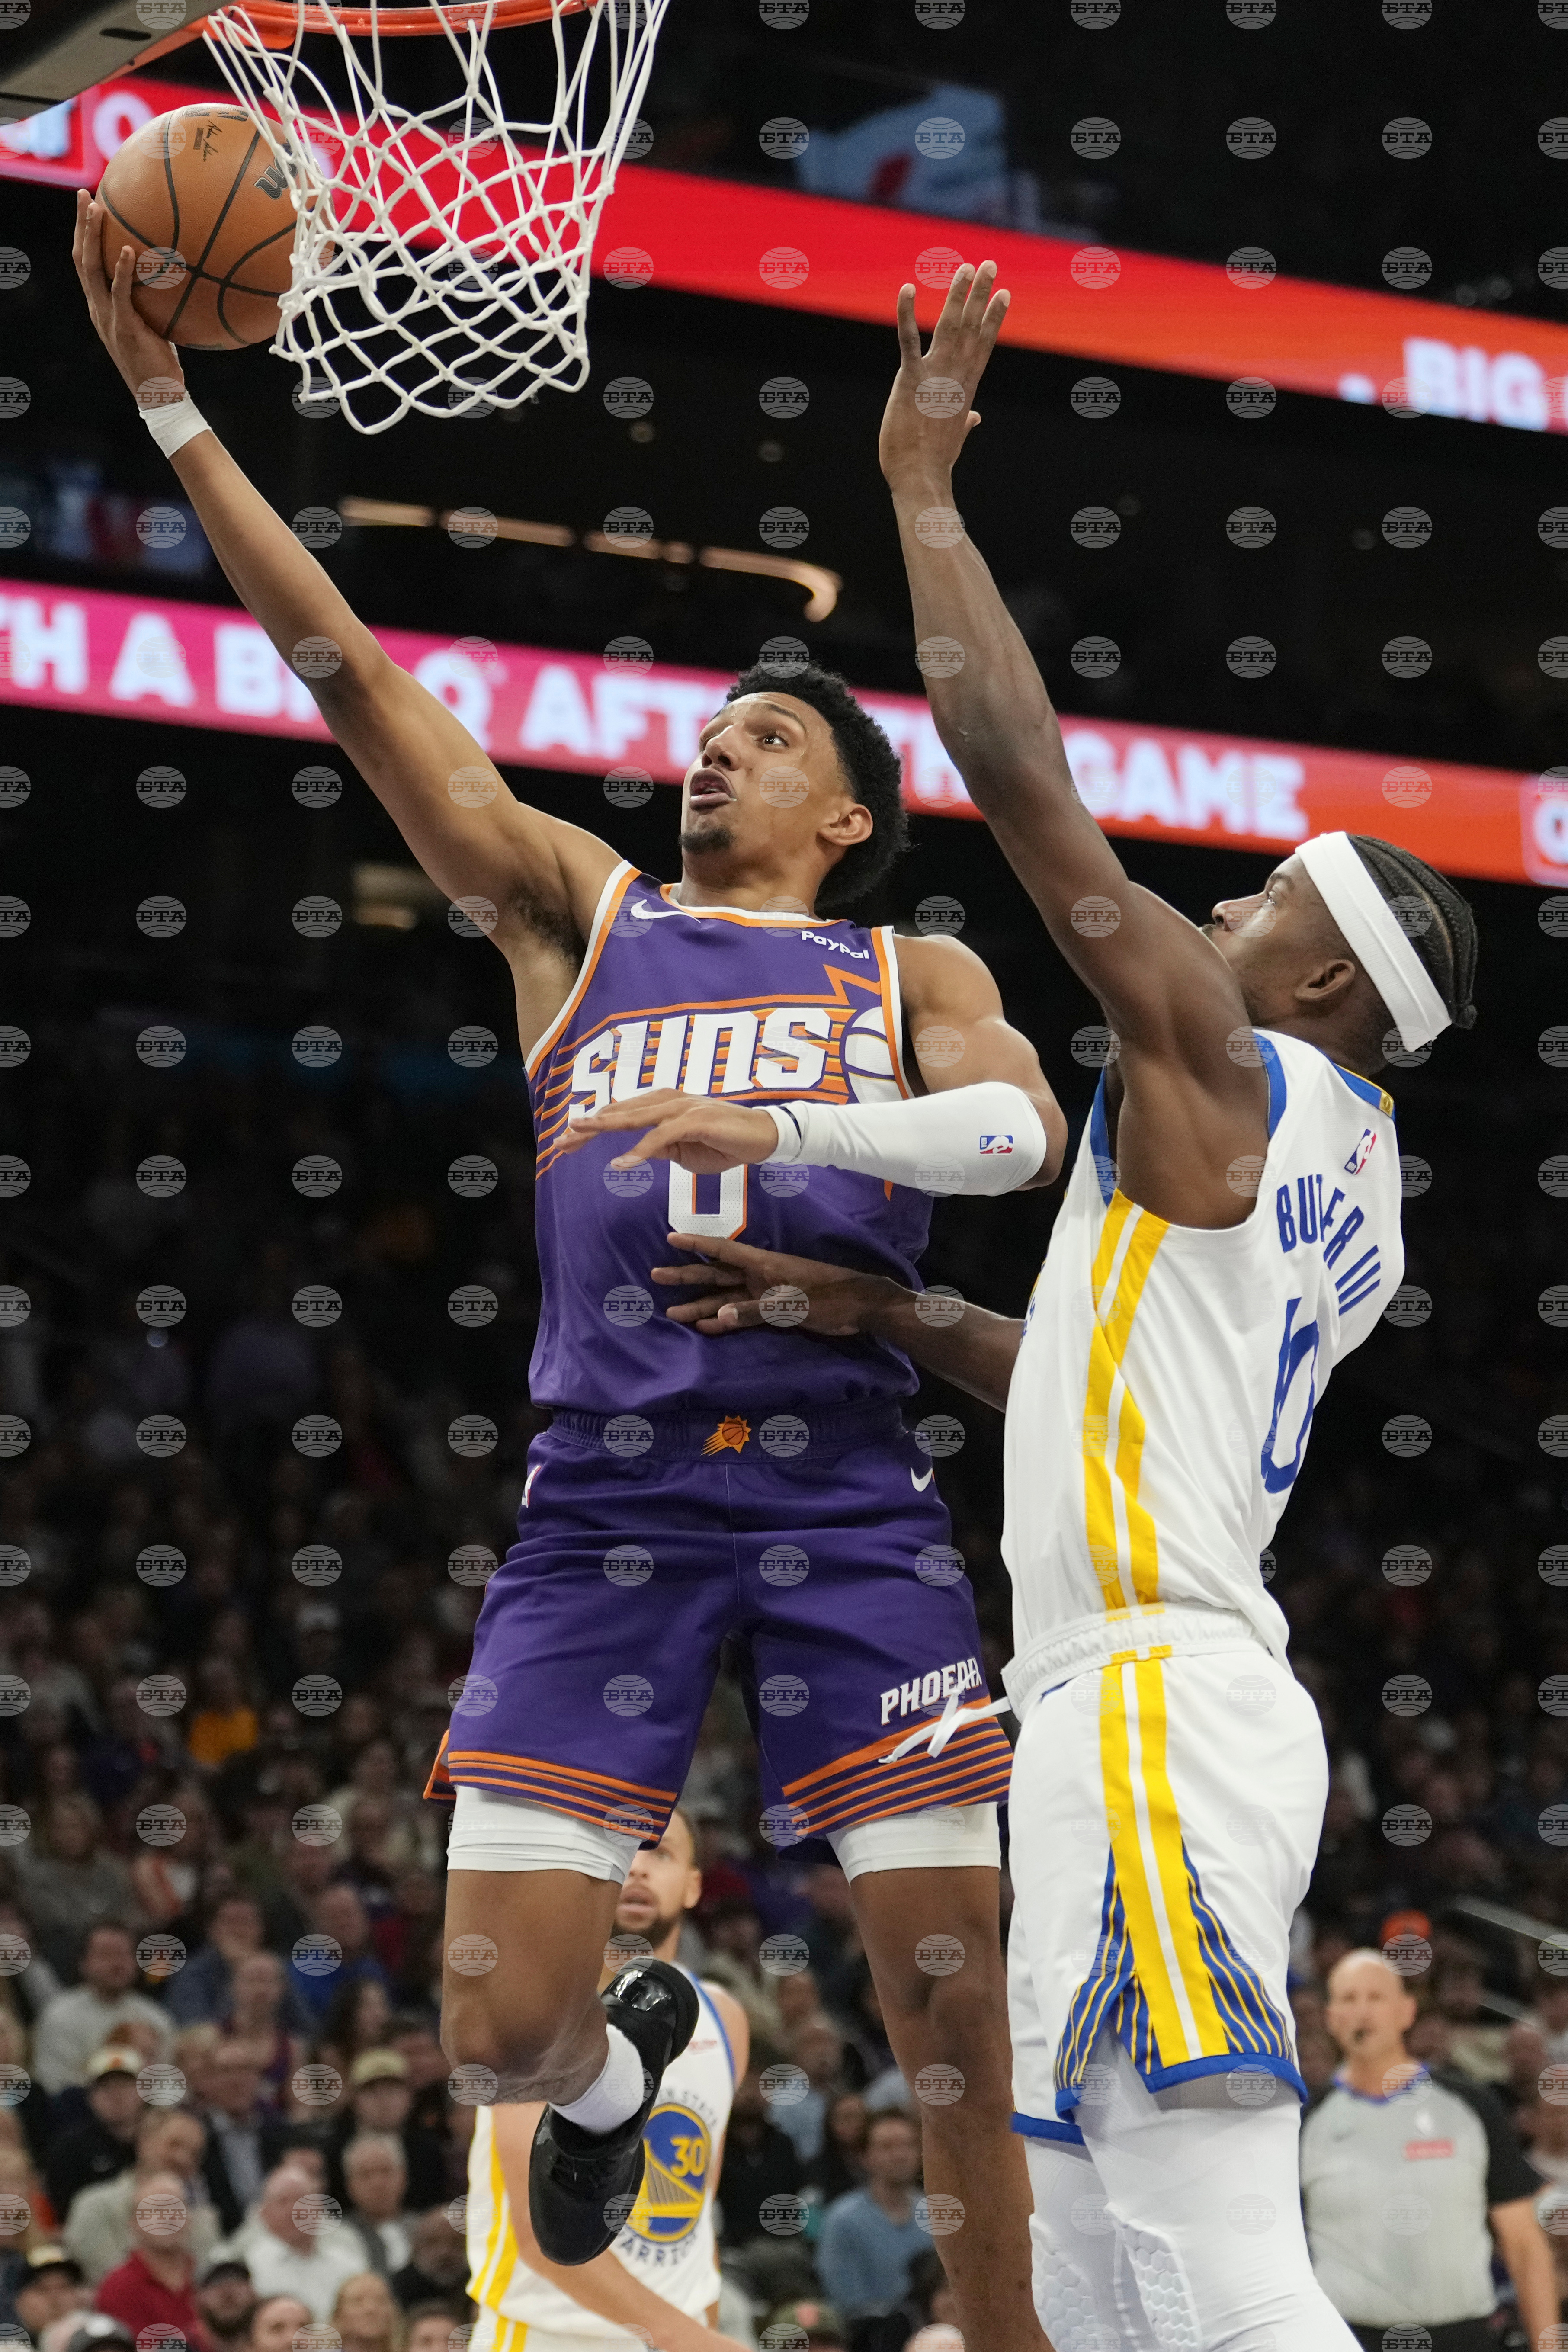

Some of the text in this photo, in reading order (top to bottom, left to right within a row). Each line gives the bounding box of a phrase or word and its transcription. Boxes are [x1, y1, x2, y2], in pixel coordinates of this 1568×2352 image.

[1403, 336, 1549, 433] BIG
[0, 594, 89, 695] H
[108, 610, 198, 709] A
[520, 663, 731, 770] AFT
[801, 930, 869, 959] PayPal
[670, 2136, 707, 2178] 30
